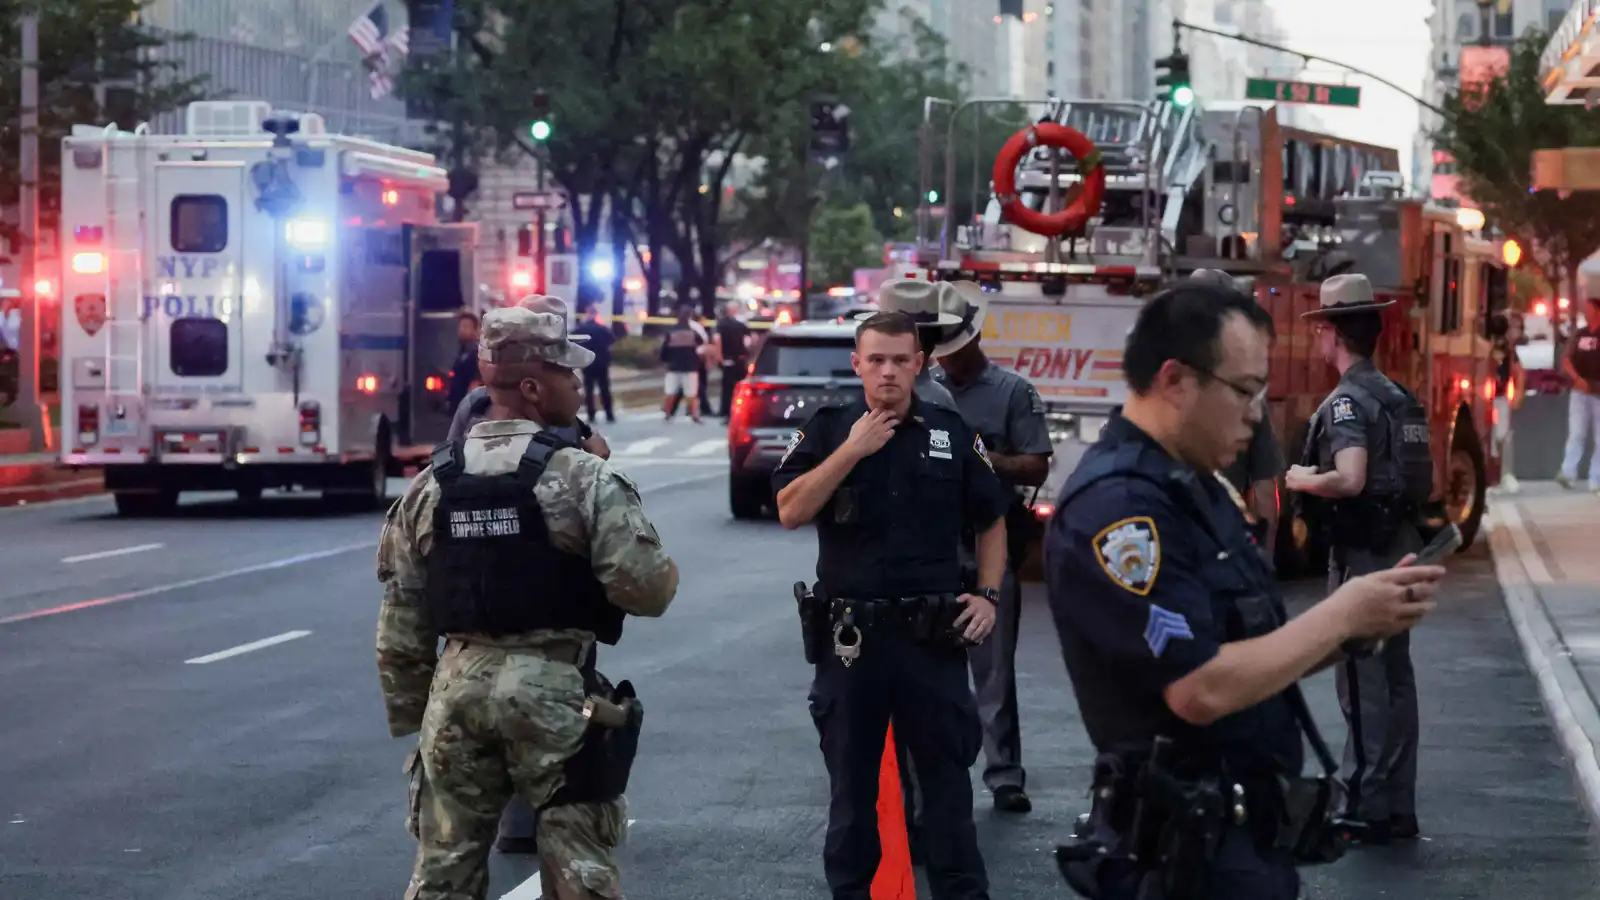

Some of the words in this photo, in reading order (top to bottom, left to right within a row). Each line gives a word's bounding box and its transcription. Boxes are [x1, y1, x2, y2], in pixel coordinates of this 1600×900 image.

[156, 256, 233, 278] NYP
[981, 311, 1072, 342] ADDER
[1015, 346, 1093, 380] FDNY
[450, 511, 470, 523] JOINT
[471, 509, 492, 522] TASK
[493, 507, 518, 520] FORCE
[451, 522, 485, 538] EMPIRE
[486, 519, 520, 536] SHIELD
